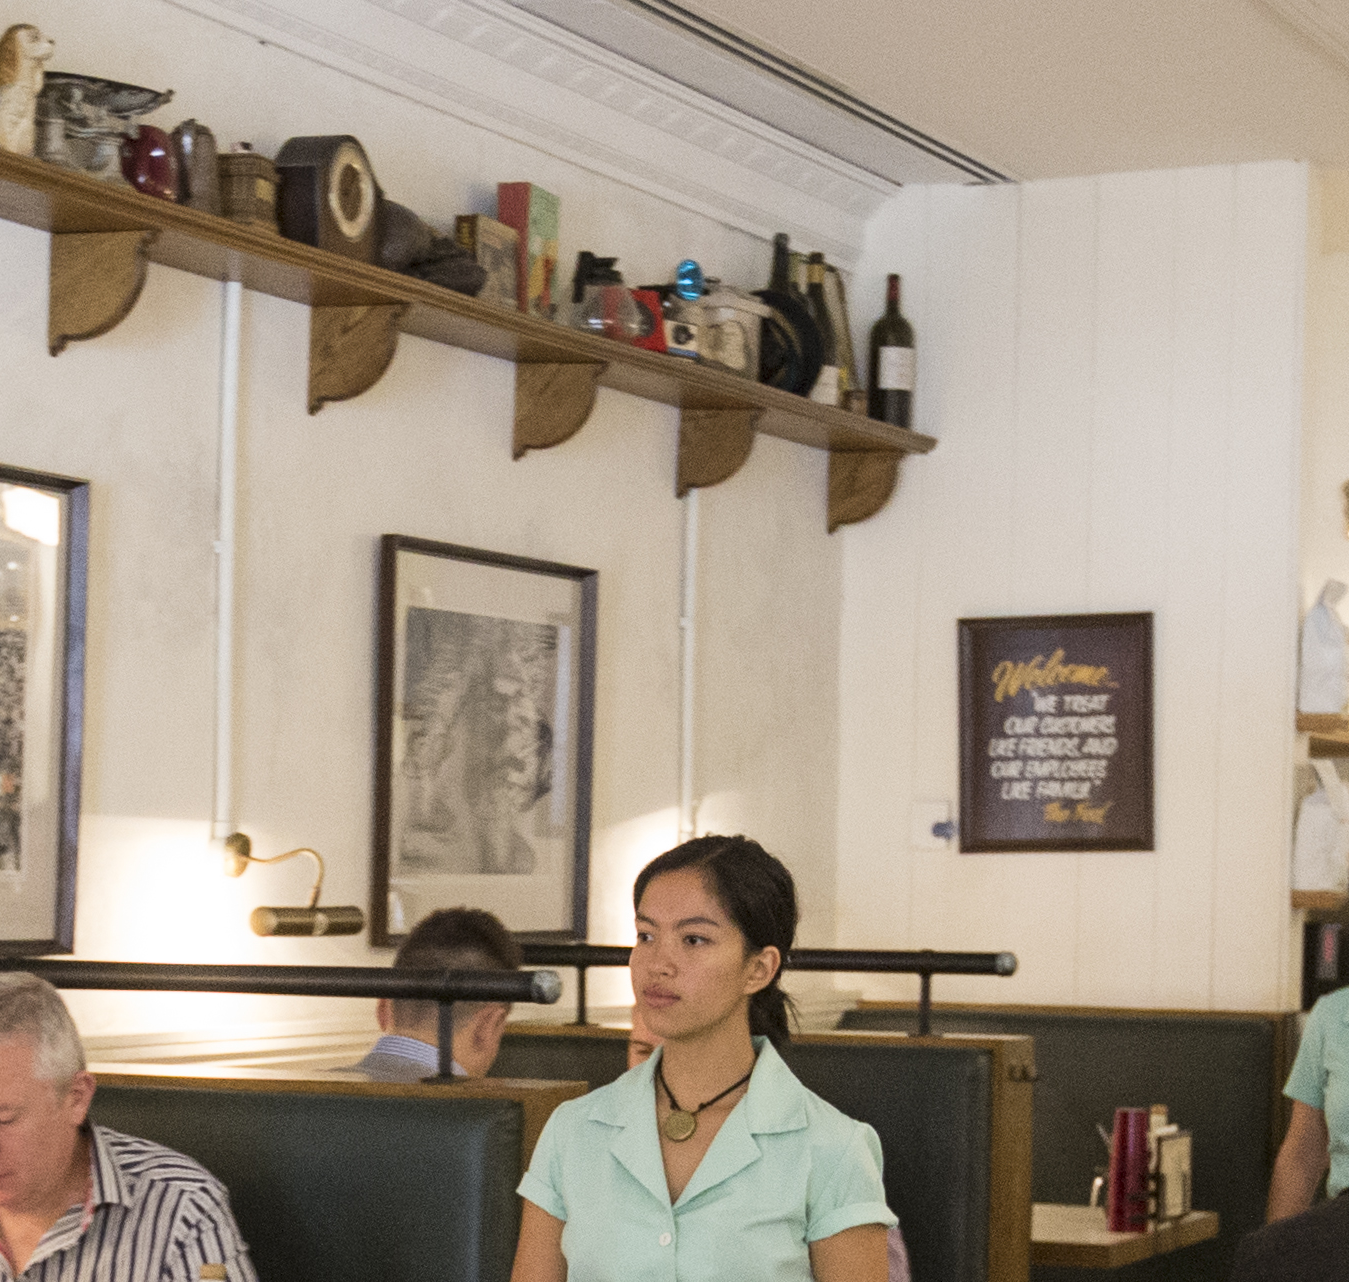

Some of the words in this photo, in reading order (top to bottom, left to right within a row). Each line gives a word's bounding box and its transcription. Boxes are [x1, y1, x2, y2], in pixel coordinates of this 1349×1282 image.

[1063, 694, 1110, 713] TREAT
[1003, 715, 1039, 736] OUR
[1039, 714, 1117, 735] CUSTOMERS
[988, 738, 1018, 758] LIKE
[1081, 736, 1119, 756] AND
[990, 760, 1023, 780] OUR
[1001, 780, 1034, 800] LIKE
